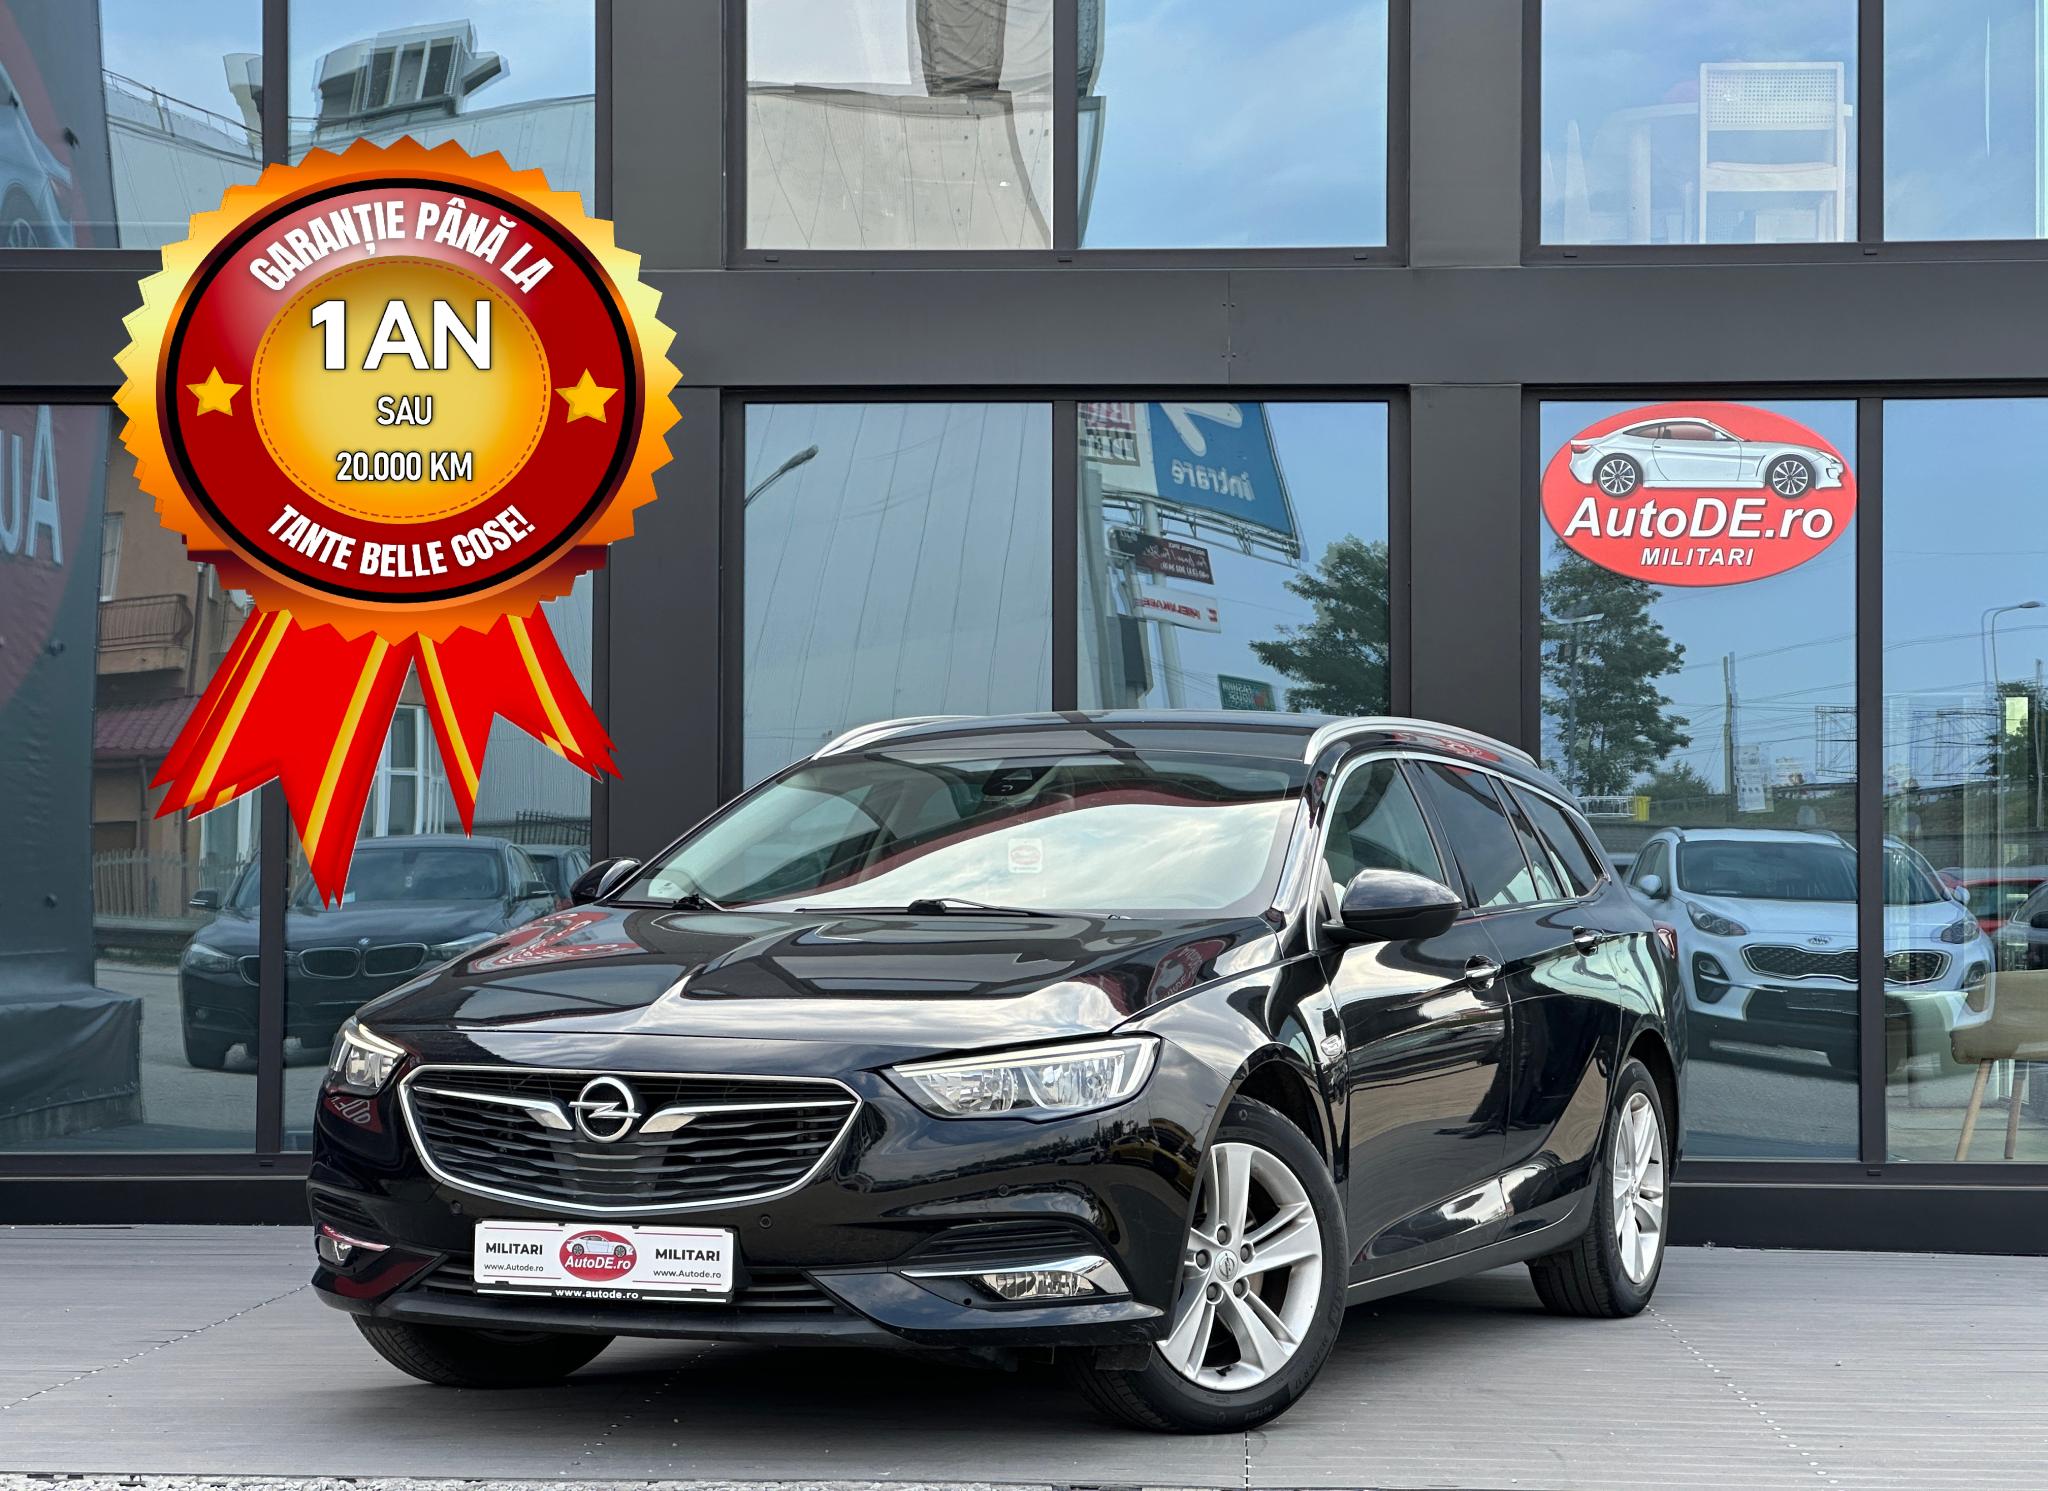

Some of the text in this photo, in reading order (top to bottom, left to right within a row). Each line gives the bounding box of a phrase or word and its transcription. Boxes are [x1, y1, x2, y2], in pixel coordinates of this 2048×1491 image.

[1564, 497, 1834, 540] AutoDE.ro
[1640, 547, 1754, 567] MILITARI
[485, 1242, 543, 1256] MILITARI
[655, 1248, 721, 1262] MILITARI
[483, 1262, 544, 1273] www.Autode.ro
[564, 1255, 631, 1270] AutoDE.ro
[653, 1269, 722, 1279] www.Autode.ro
[554, 1287, 640, 1300] www.autode.ro
